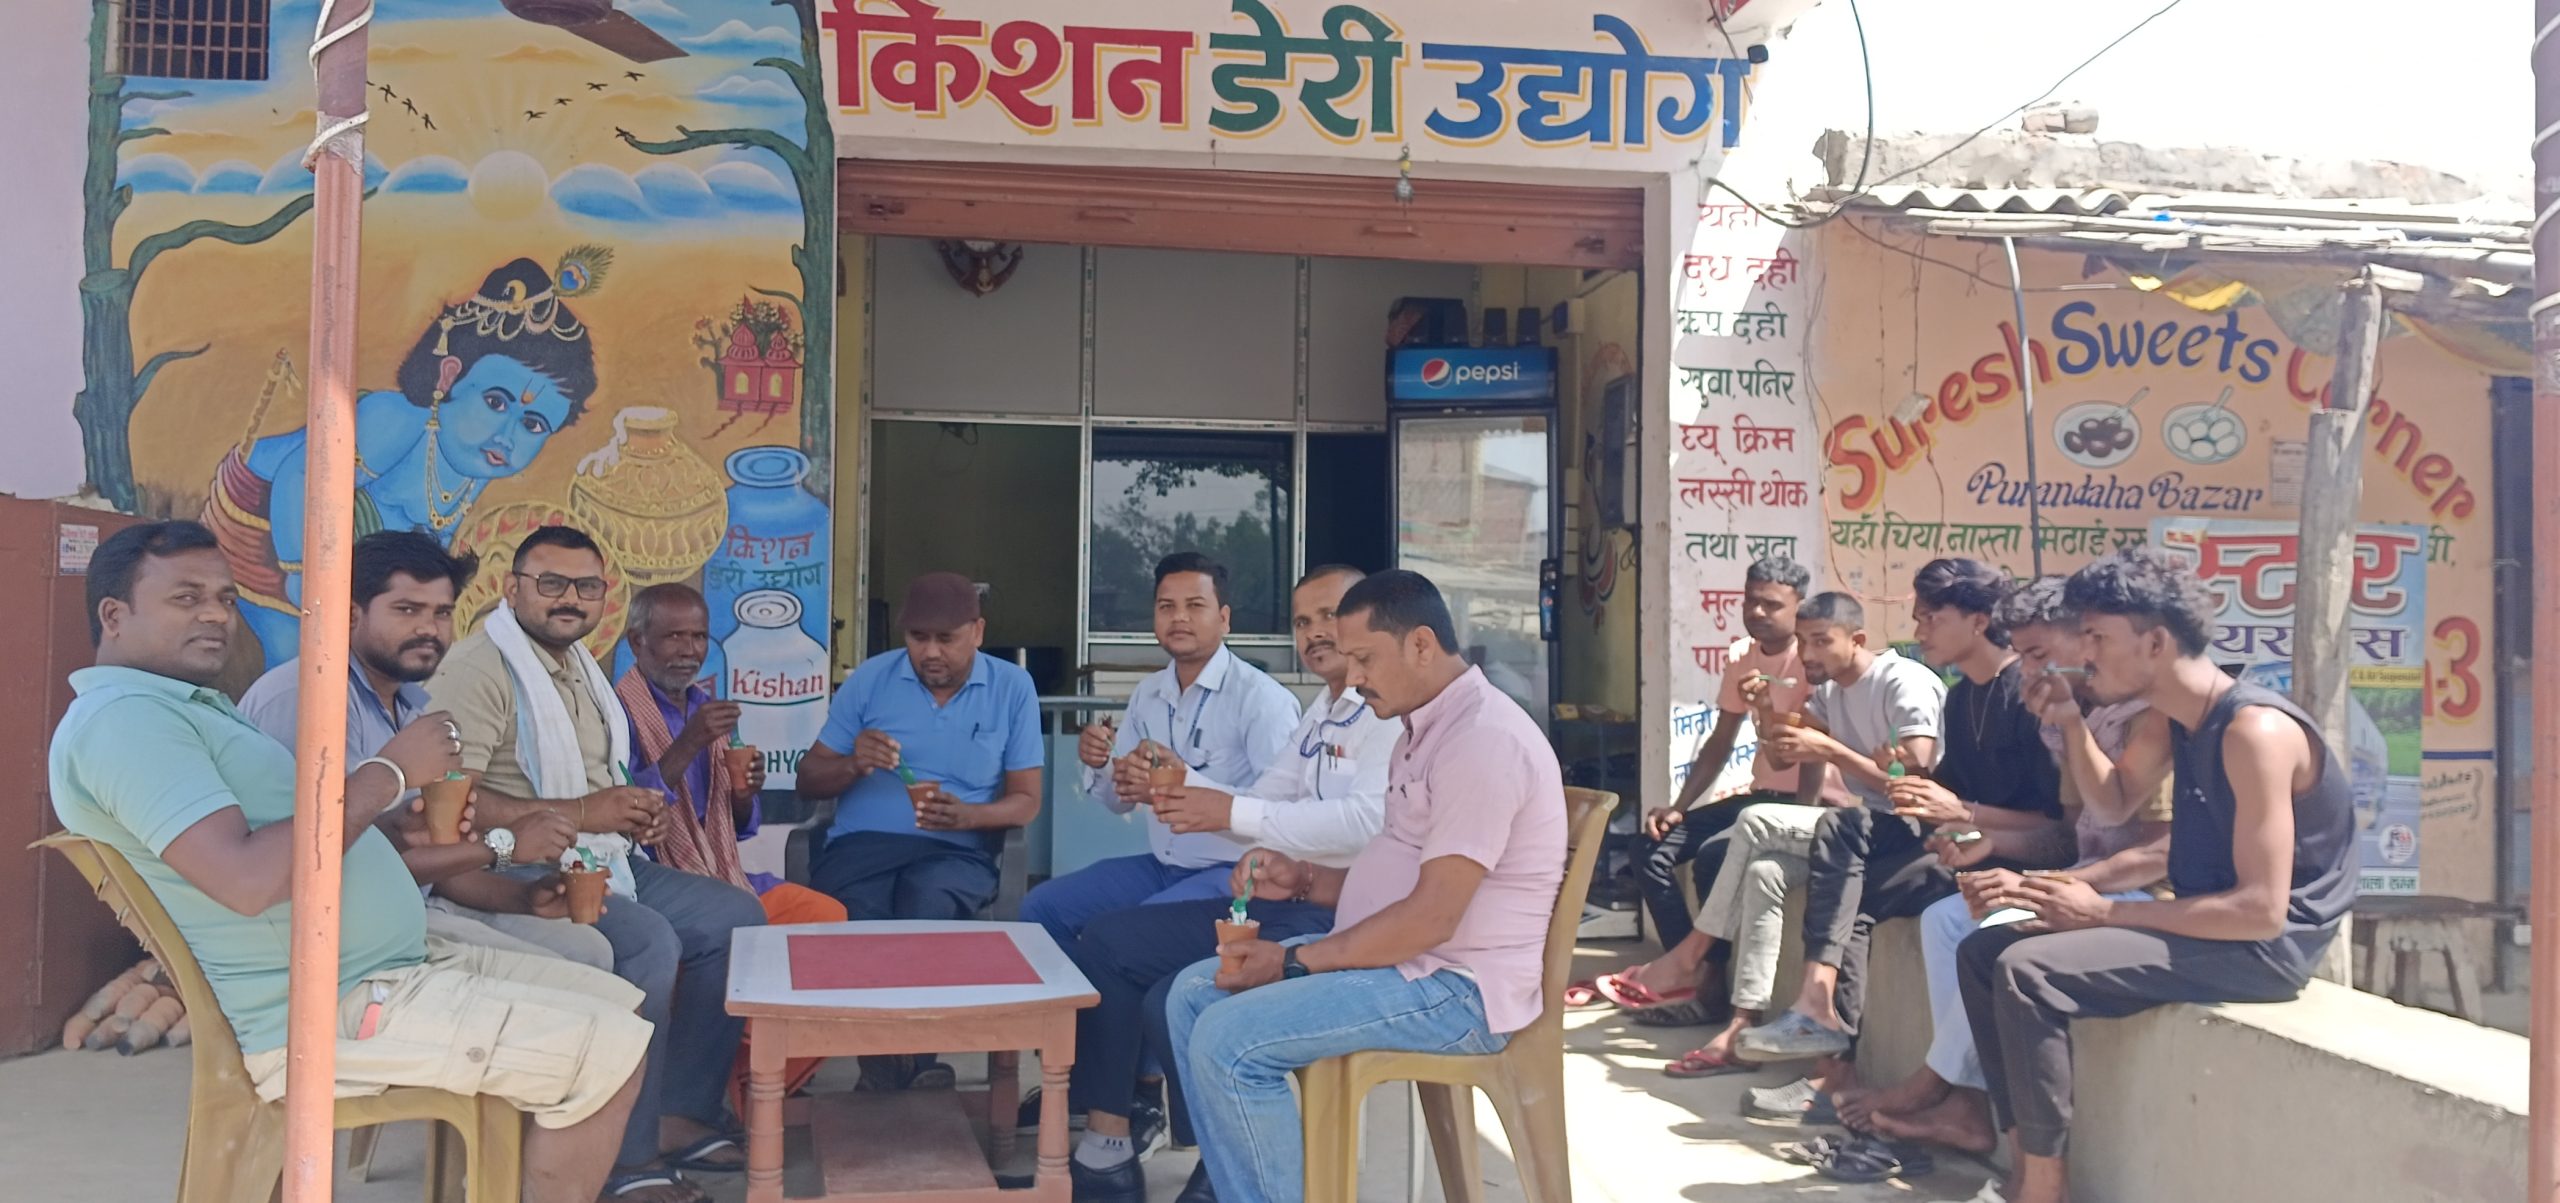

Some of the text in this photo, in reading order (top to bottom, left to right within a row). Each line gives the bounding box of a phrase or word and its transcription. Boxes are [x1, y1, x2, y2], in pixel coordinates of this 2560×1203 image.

[821, 0, 1751, 149] किशन डेरी उद्योग
[1747, 247, 1798, 290] दही
[1733, 302, 1787, 344] दही
[1455, 361, 1519, 385] pepsi
[1737, 359, 1795, 405] पनिर
[1824, 321, 2052, 511] Suresh
[2052, 301, 2279, 383] Sweets
[1733, 414, 1795, 454] क्रिम
[1678, 468, 1808, 510] लस्सी थोक
[1967, 462, 2144, 510] Purandaha
[2148, 471, 2264, 512] Bazar
[726, 524, 815, 564] किशन
[1685, 532, 1739, 562] तथा
[1948, 524, 2023, 562] नास्ता
[731, 668, 824, 699] Kishan
